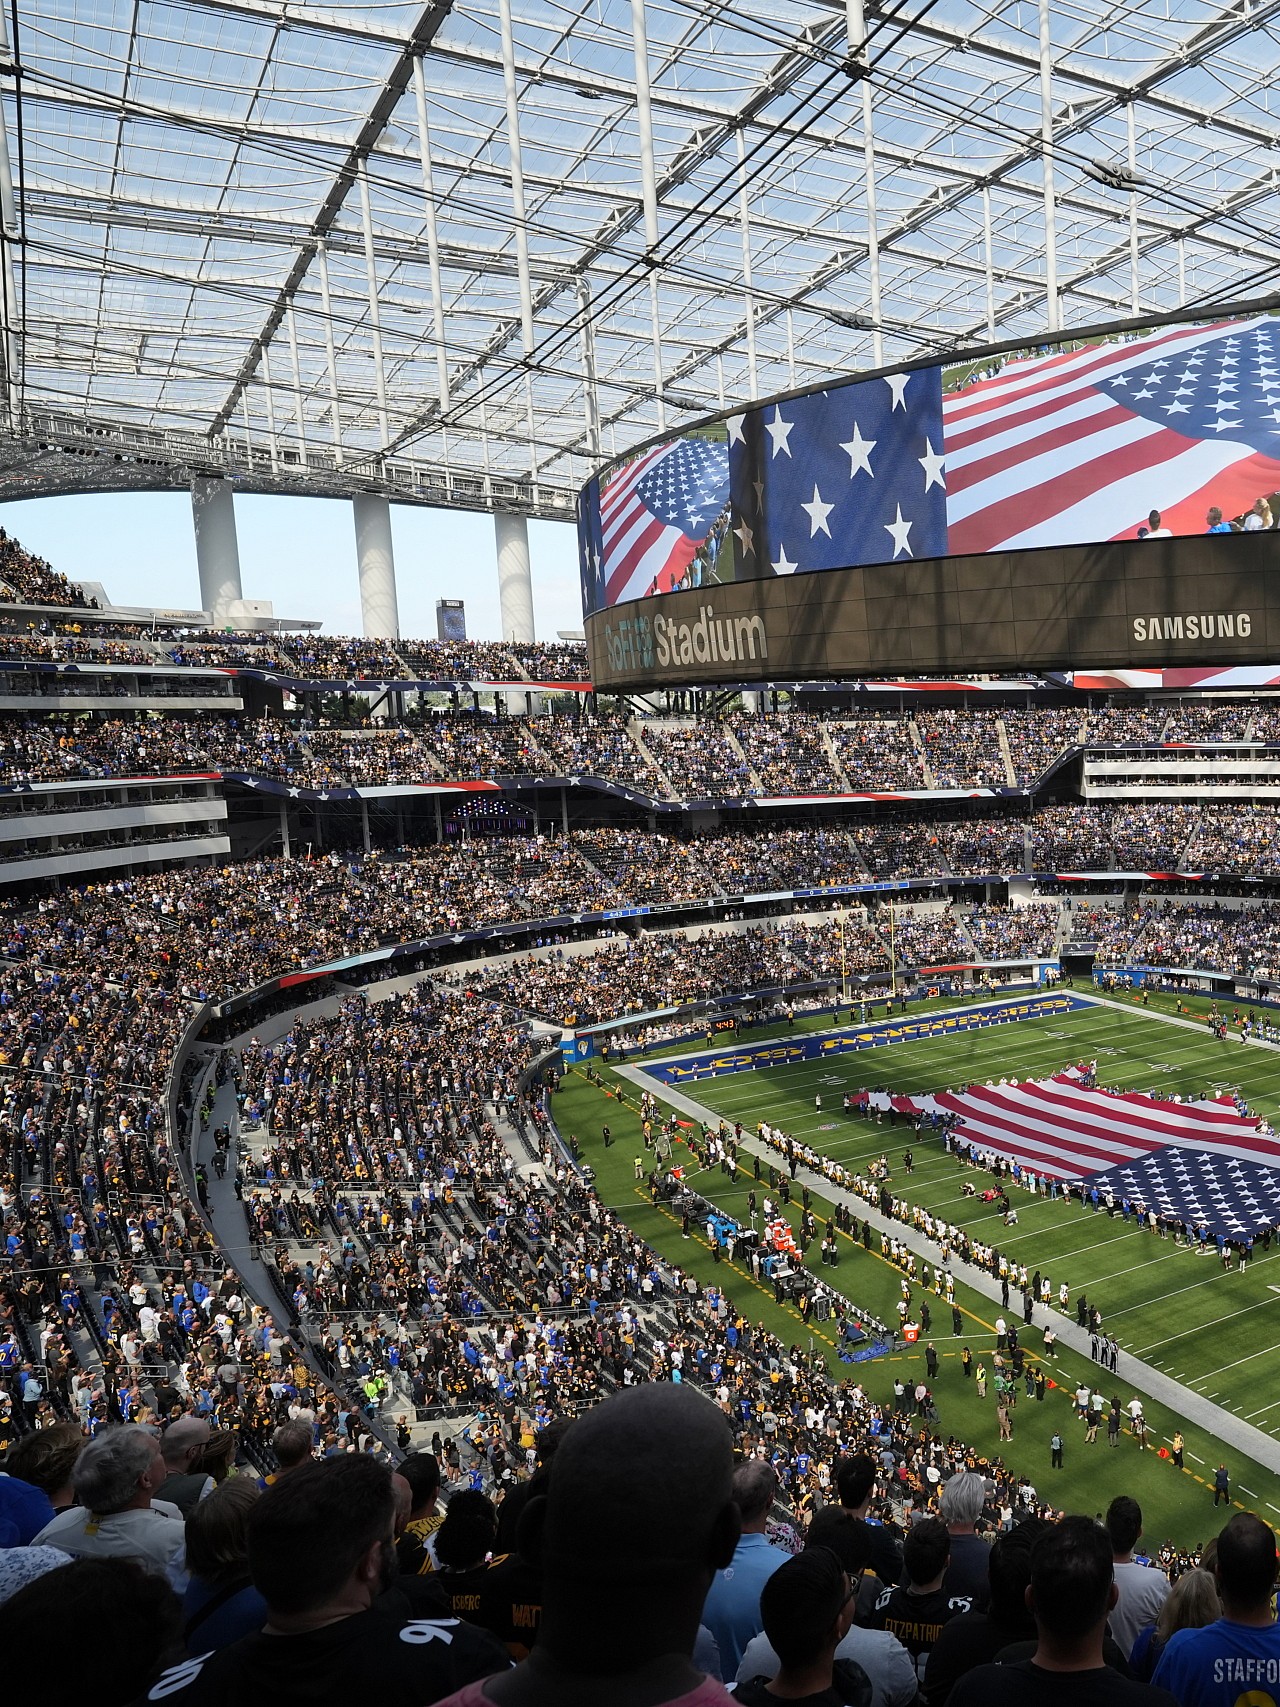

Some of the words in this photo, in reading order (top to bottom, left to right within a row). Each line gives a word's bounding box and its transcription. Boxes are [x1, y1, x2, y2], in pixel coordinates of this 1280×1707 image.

[1133, 613, 1251, 641] SAMSUNG
[605, 620, 637, 672] SoFi
[654, 604, 768, 667] Stadium
[927, 987, 938, 996] 25
[715, 1019, 734, 1029] 4:43
[666, 1047, 801, 1076] LOS
[822, 999, 1074, 1049] ANGELES
[907, 1331, 915, 1339] G
[800, 1460, 806, 1469] 9
[1162, 1551, 1171, 1562] 99
[884, 1617, 946, 1643] FITZPATRIC
